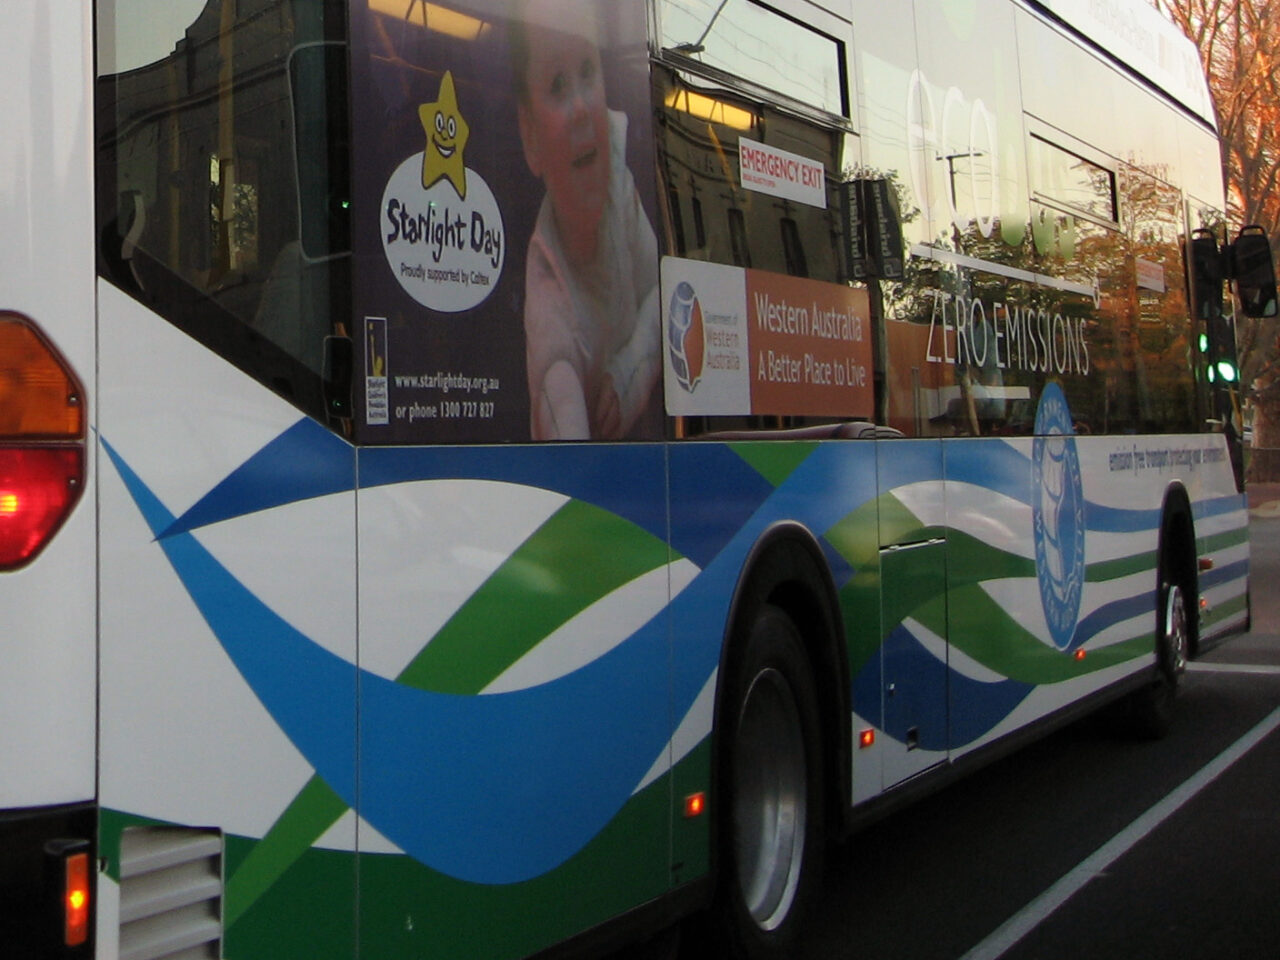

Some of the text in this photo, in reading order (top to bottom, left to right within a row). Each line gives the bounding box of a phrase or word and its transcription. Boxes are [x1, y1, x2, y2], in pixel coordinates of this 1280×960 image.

[741, 145, 800, 183] EMERGENCY
[802, 164, 822, 190] EXIT
[387, 198, 501, 270] Starlight Day
[400, 262, 426, 282] Proudly
[753, 291, 862, 342] Western Australia
[925, 291, 1090, 376] ZERO EMISSIONS
[395, 372, 500, 394] www.starlightday.org.au
[757, 350, 866, 387] A Better Place to Live
[395, 404, 408, 418] or
[409, 402, 437, 423] phone
[439, 401, 460, 418] 1300
[462, 401, 477, 418] 727
